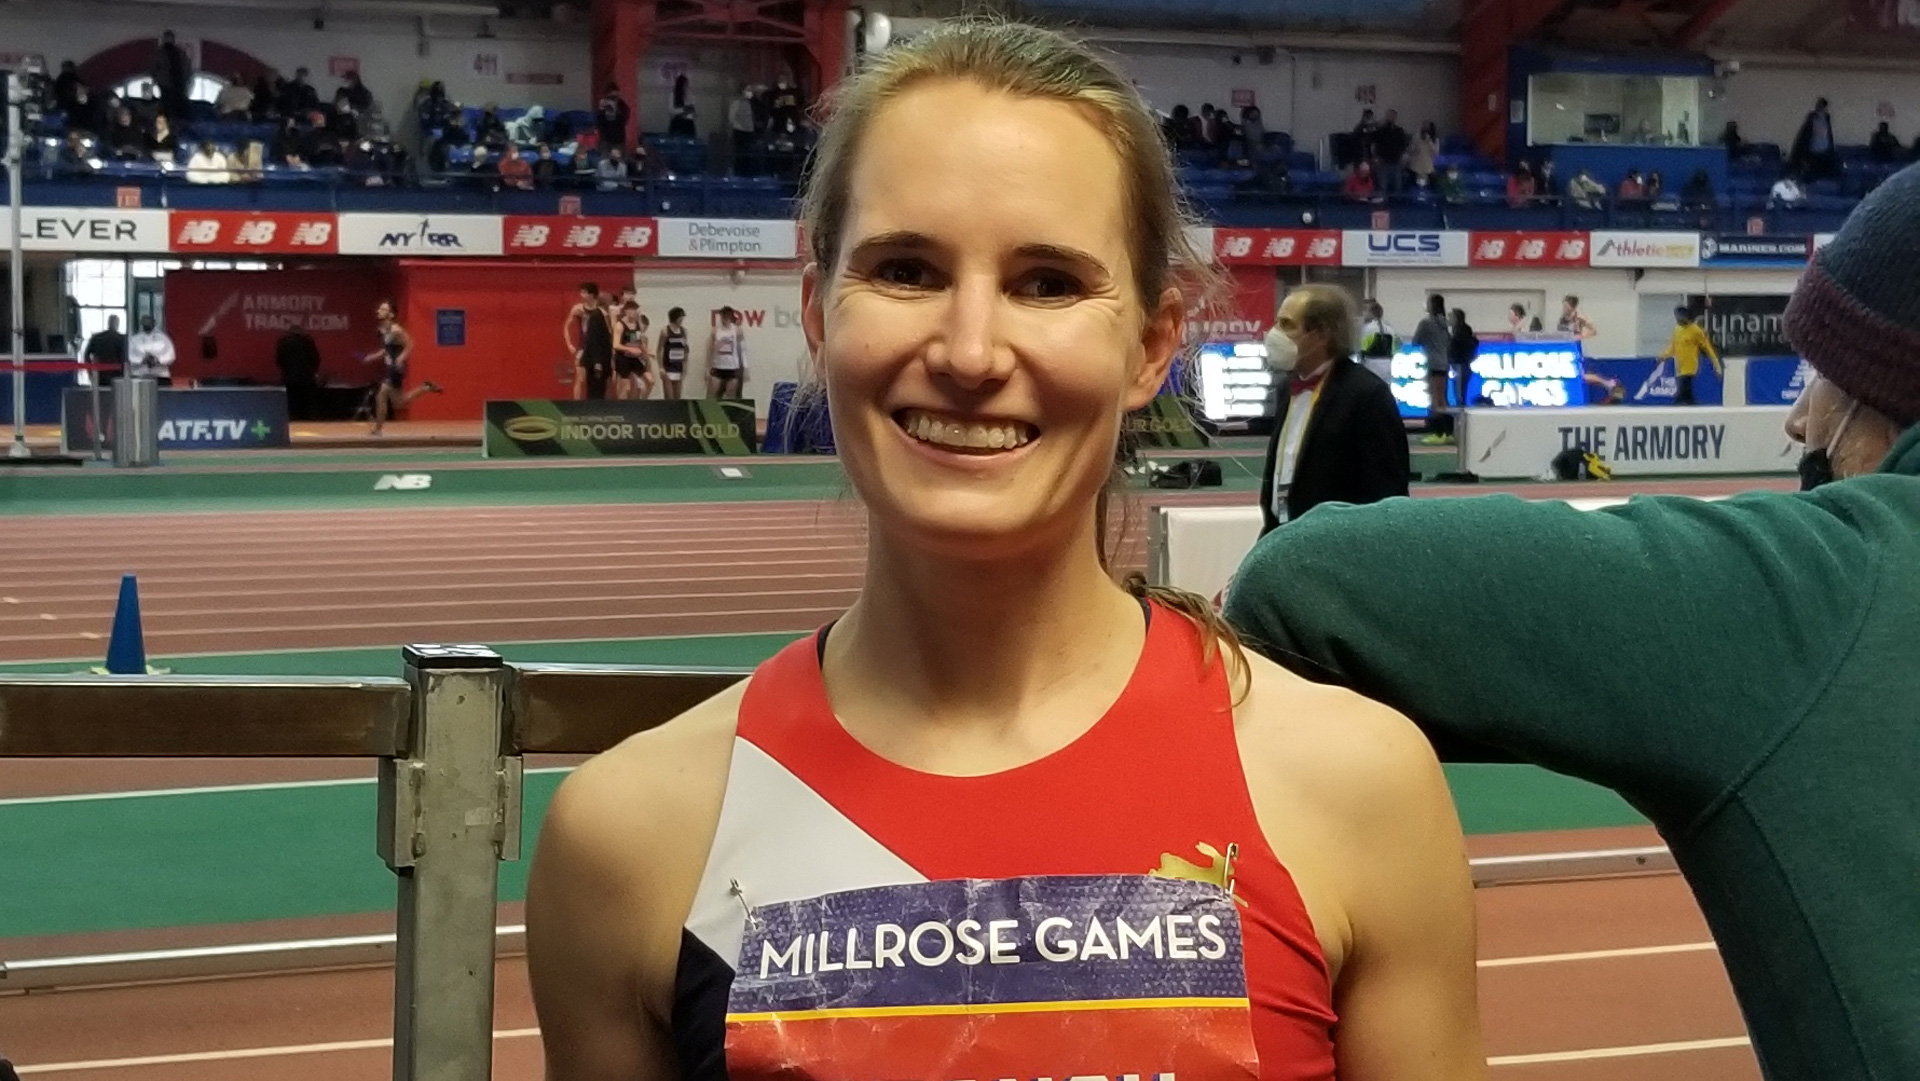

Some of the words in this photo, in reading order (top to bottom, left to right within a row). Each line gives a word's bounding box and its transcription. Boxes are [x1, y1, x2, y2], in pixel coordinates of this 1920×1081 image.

[178, 221, 220, 244] NB
[234, 221, 277, 245] NB
[290, 223, 331, 245] NB
[511, 225, 549, 247] NB
[563, 225, 601, 248] NB
[614, 226, 652, 248] NB
[688, 222, 760, 237] Debevoise
[1220, 237, 1252, 257] NB
[1263, 237, 1295, 258] NB
[1306, 237, 1337, 258] NB
[1368, 234, 1440, 252] UCS
[1475, 240, 1504, 259] NB
[1516, 240, 1545, 259] NB
[1558, 239, 1585, 259] NB
[158, 419, 248, 440] ATF.TV
[561, 424, 633, 440] INDOOR
[638, 423, 687, 439] TOUR
[689, 422, 741, 439] GOLD
[1558, 426, 1606, 461] THE
[1613, 425, 1725, 461] ARMORY
[374, 474, 432, 490] NB
[760, 919, 1020, 979] MILLROSE
[1036, 914, 1225, 963] GAMES
